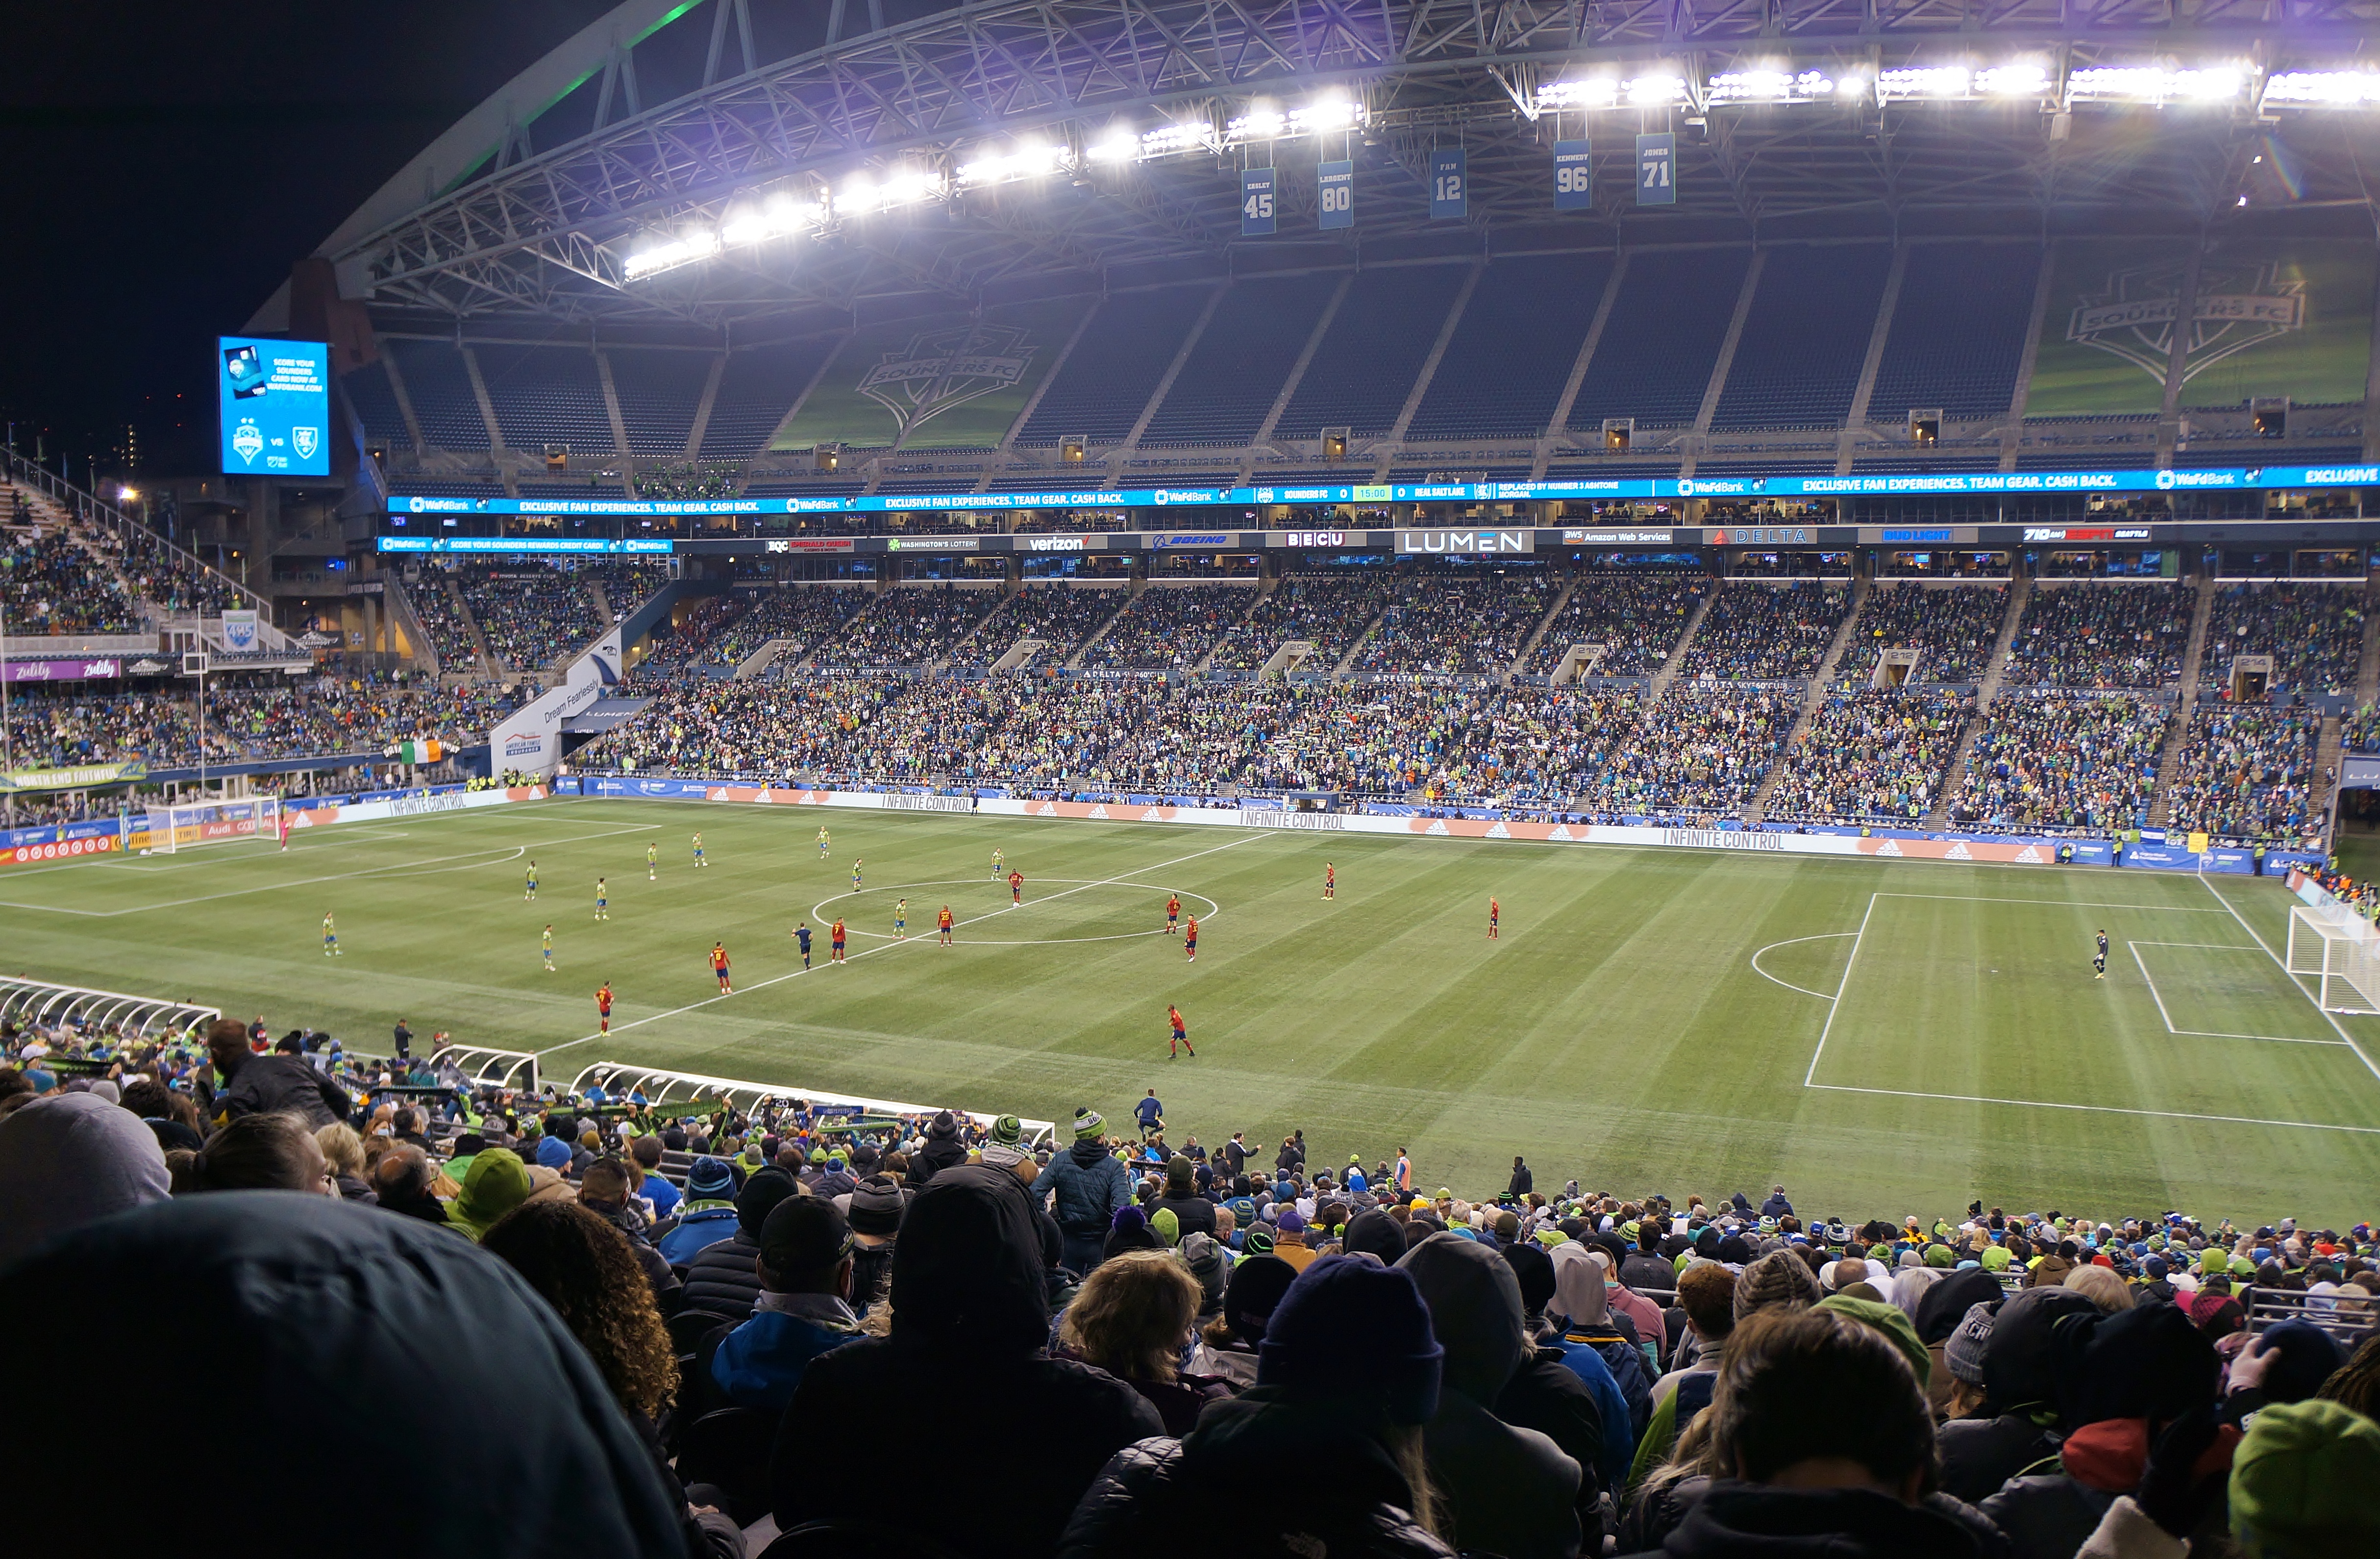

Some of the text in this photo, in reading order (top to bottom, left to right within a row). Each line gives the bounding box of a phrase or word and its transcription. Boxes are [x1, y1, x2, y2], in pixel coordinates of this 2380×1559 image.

[1557, 153, 1588, 162] KENNEDY
[1644, 148, 1668, 157] JONES
[1558, 166, 1588, 193] 96
[1642, 161, 1669, 188] 71
[1437, 176, 1461, 201] 12
[1322, 186, 1349, 212] 80
[1244, 194, 1272, 219] 45
[273, 358, 315, 368] SCORE YOUR
[276, 367, 313, 376] SOUNDERS
[992, 365, 1016, 376] FC
[1803, 474, 2117, 491] EXCLUSIVE FAN EXPERIENCES. TEAM GEAR. CASH BACK.
[2305, 468, 2379, 483] EXCLUSIVE
[1284, 490, 1328, 499] SOUNDERS FC
[1339, 488, 1348, 498] 0
[1361, 489, 1385, 498] 15:00
[1398, 487, 1406, 497] 0
[1414, 487, 1465, 497] REAL SALT LAKE
[520, 502, 759, 513] EXCLUSIVE FAN EXPERIENCES. TEAM GEAR. CASH BACK.
[886, 494, 1124, 508] EXCLUSIVE FAN EXPERIENCES. TEAM GEAR. CASH BACK.
[1170, 536, 1227, 544] BOEING
[1618, 532, 1636, 541] Web
[1638, 532, 1671, 541] Services
[1736, 529, 1807, 543] DELTA
[1884, 530, 1951, 541] BUD LIGHT
[2023, 528, 2051, 540] 710
[2065, 529, 2113, 540] ESPN
[768, 541, 789, 553] EQC
[1030, 536, 1083, 551] verizon
[1405, 531, 1522, 553] LUMEN
[16, 662, 50, 679] zulily
[84, 659, 115, 678] zulily
[545, 679, 598, 724] Dream Fearlessly
[15, 767, 118, 787] NORTH END FAITHFUL
[389, 795, 467, 816] INFINITE CONTROL
[883, 795, 970, 811] INFINITE CONTROL
[1240, 811, 1345, 830] INFINITE CONTROL
[208, 824, 230, 836] Audi
[1662, 829, 1785, 850] INFINITE CONTROL
[775, 1099, 789, 1108] 20
